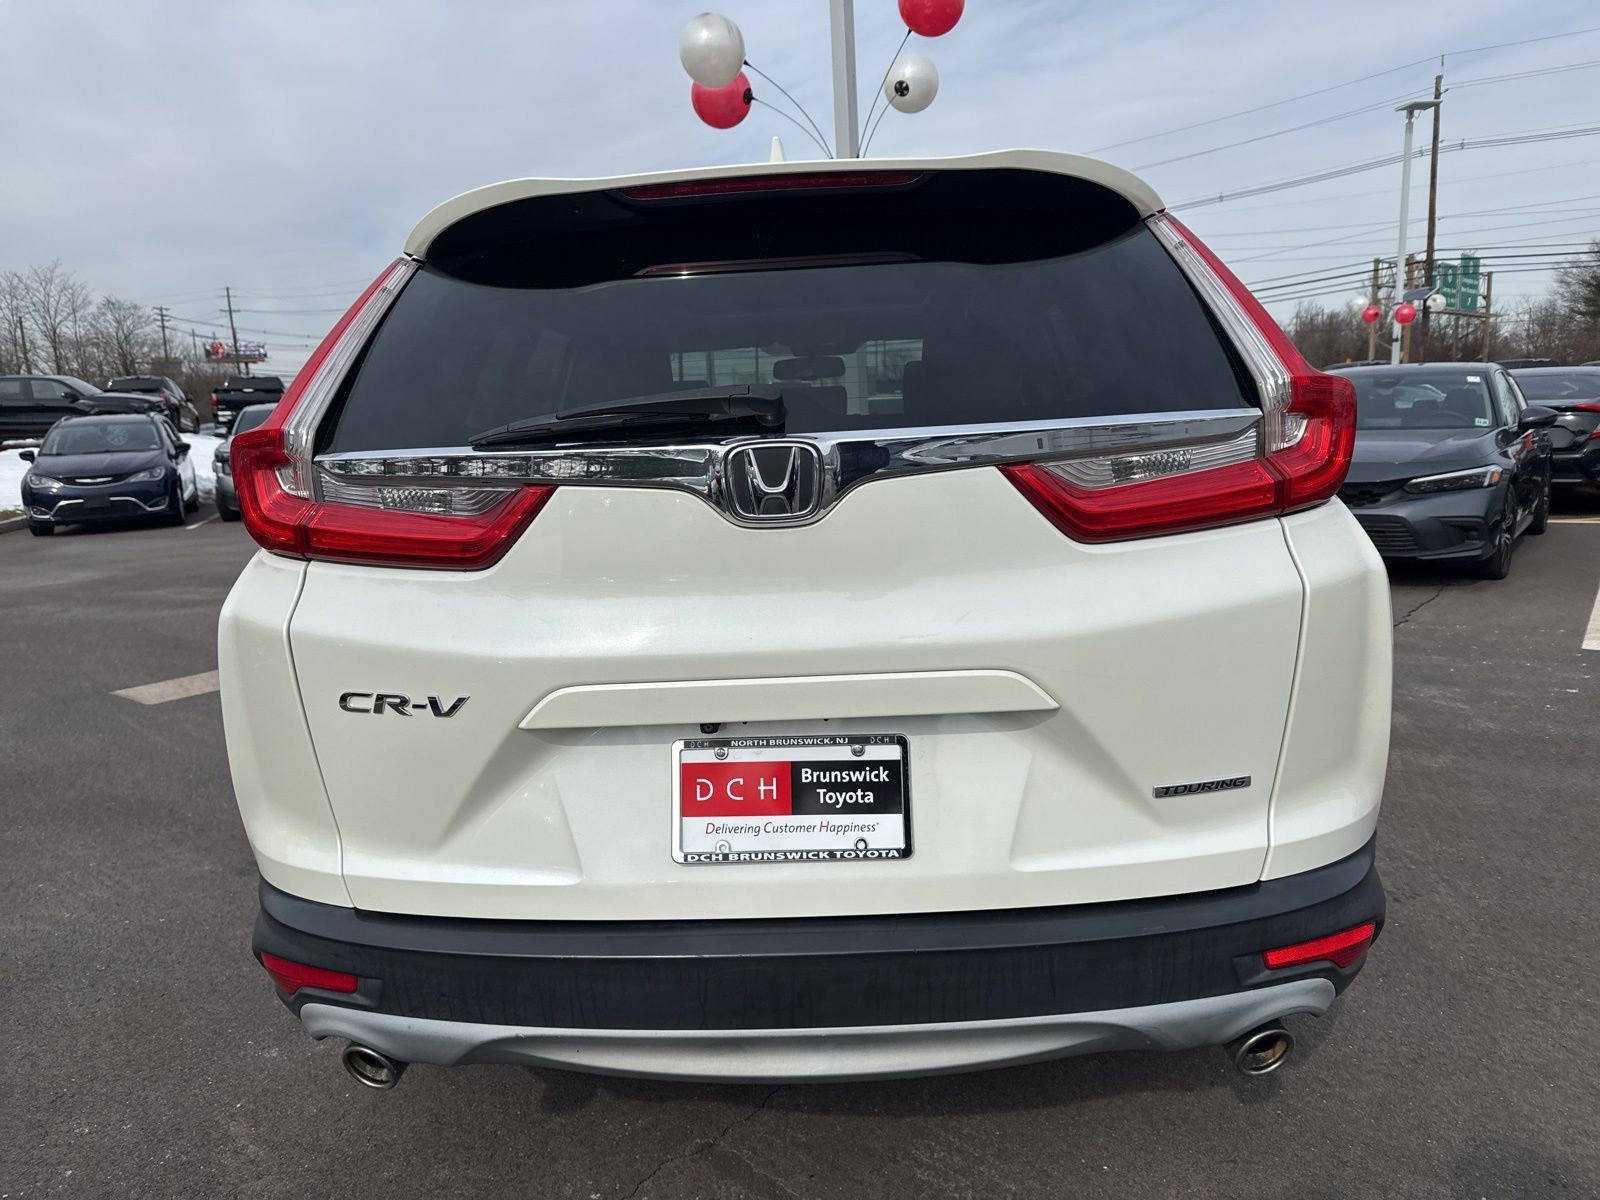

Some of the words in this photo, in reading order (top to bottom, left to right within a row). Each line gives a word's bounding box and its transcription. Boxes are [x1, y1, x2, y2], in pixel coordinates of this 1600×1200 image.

[339, 692, 470, 717] CR-V
[730, 739, 767, 747] NORTH
[801, 766, 889, 783] Brunswick
[696, 777, 777, 801] DCH
[1161, 777, 1246, 796] TOURING
[816, 788, 874, 808] Toyota
[705, 822, 761, 837] Delivering
[763, 821, 817, 834] Customer
[687, 852, 723, 862] DCH
[728, 851, 830, 861] BRUNSWICK
[833, 849, 900, 859] TOYOTA
